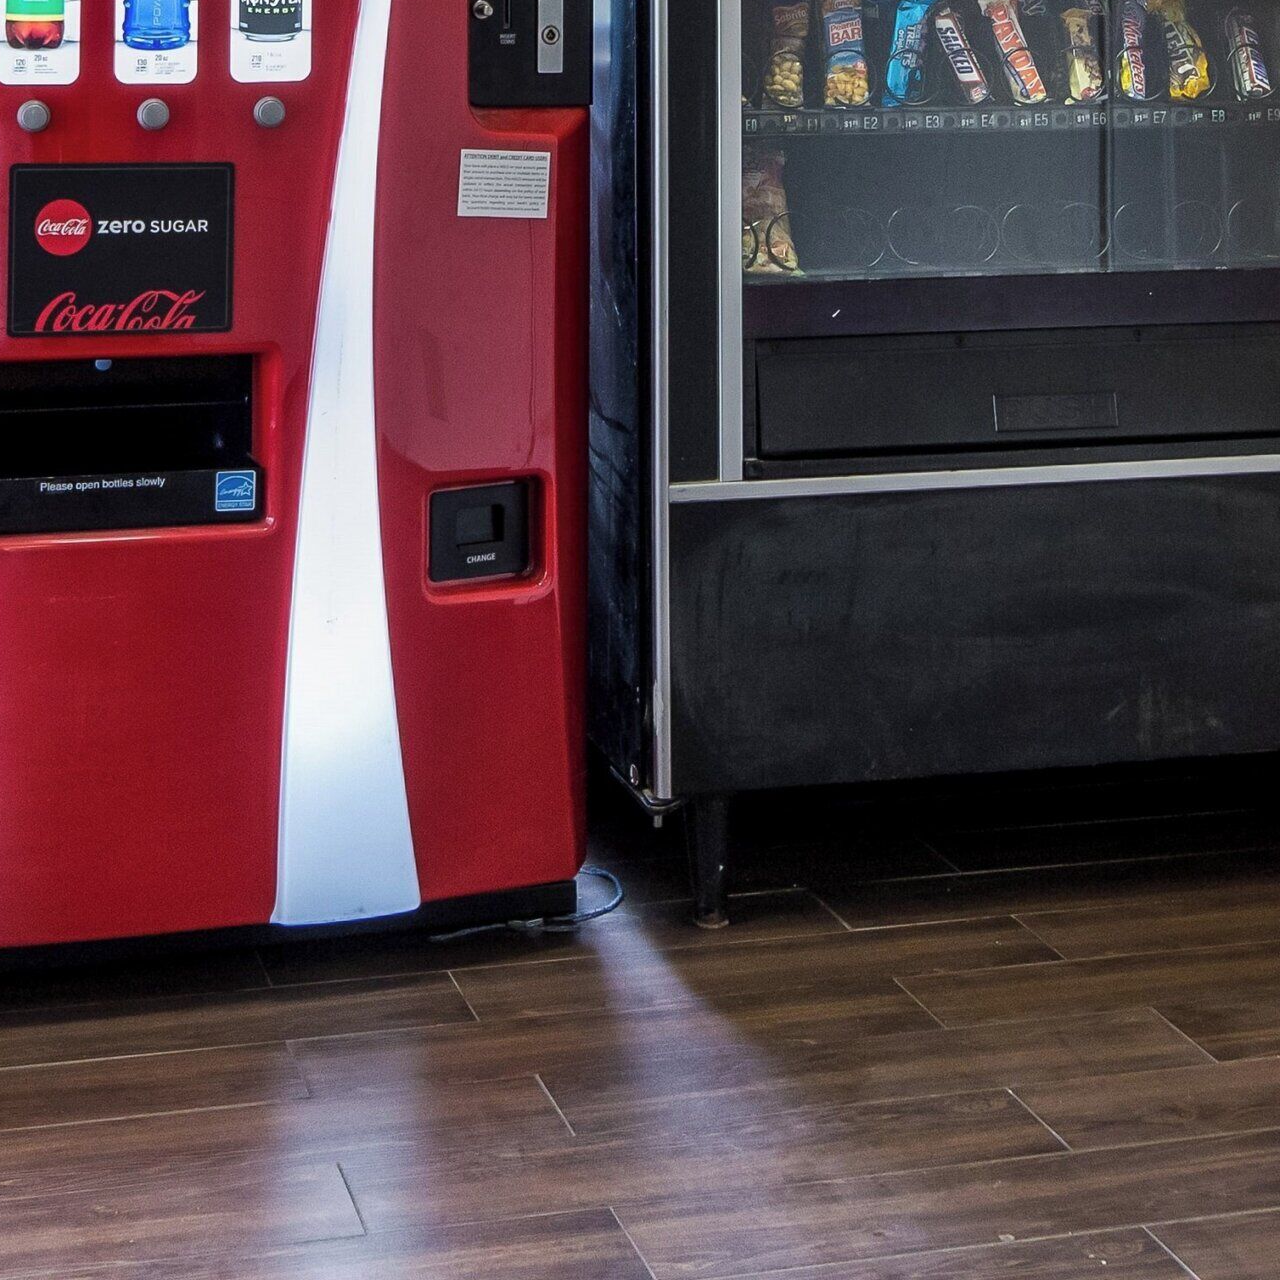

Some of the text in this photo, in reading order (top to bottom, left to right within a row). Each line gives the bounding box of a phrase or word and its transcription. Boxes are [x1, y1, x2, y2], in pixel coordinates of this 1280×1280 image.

[830, 20, 861, 31] Peanut
[831, 28, 862, 45] BAR
[981, 115, 995, 127] E4
[1035, 114, 1049, 126] E5
[1093, 113, 1107, 125] E6
[1153, 111, 1166, 124] E7
[1211, 110, 1225, 122] E8
[1268, 109, 1280, 121] E9
[864, 117, 878, 130] E2
[926, 116, 940, 128] E3
[37, 218, 208, 236] Coca-Cola zero SUGAR
[40, 477, 166, 493] Please open bottles slowly
[467, 552, 496, 564] CHANGE
